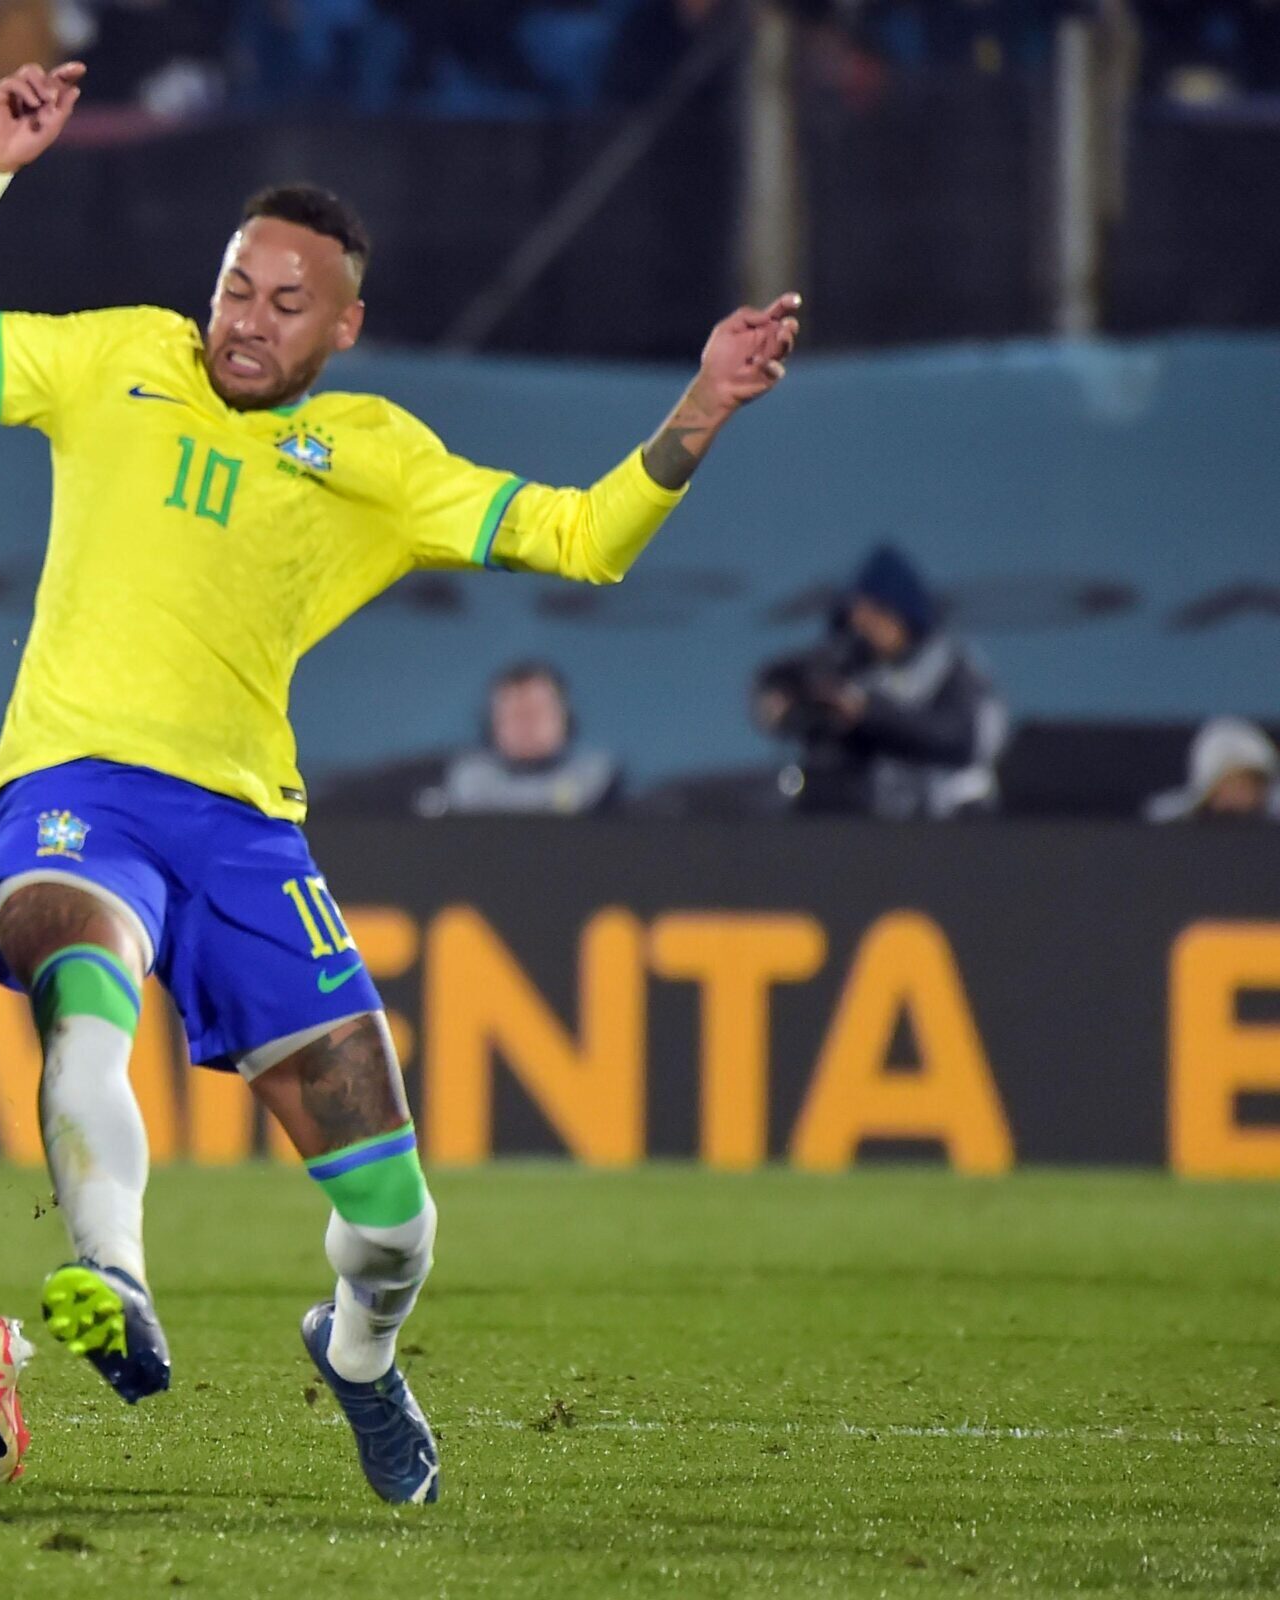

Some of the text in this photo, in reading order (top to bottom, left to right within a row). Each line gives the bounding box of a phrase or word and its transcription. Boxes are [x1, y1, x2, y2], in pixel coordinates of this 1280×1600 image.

[164, 433, 243, 528] 10
[282, 876, 357, 959] 10
[1167, 916, 1280, 1178] E
